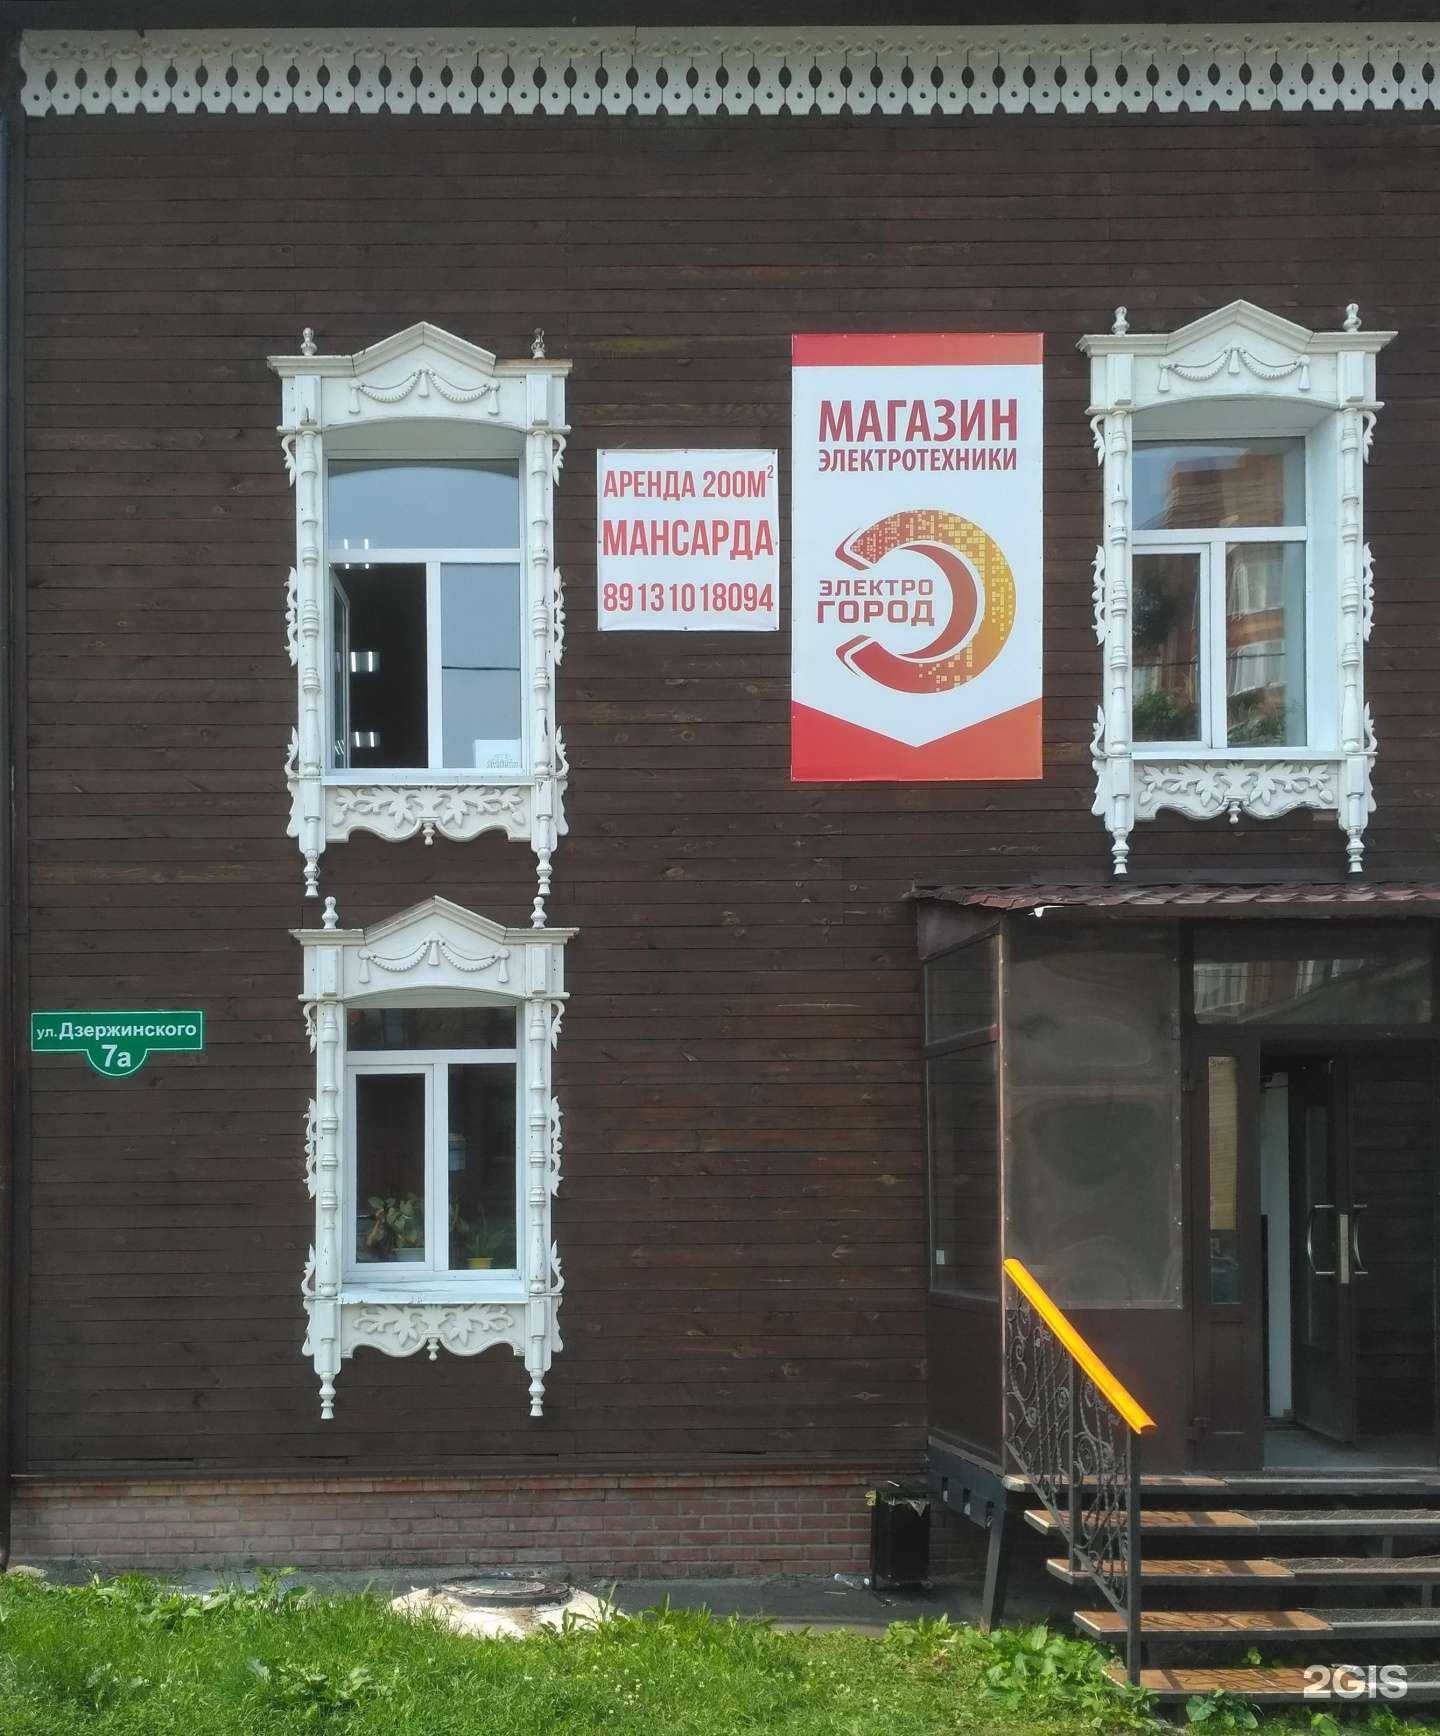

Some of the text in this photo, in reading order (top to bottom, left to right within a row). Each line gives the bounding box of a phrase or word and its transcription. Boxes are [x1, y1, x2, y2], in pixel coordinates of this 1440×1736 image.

[818, 398, 1018, 442] МАГАЗИН
[818, 447, 1017, 472] ЭЛЕКТРОТЕХНИКИ
[603, 470, 696, 501] АРЕНДА
[602, 519, 774, 561] МАНСАРДА
[603, 582, 774, 612] 89131018094
[818, 579, 934, 597] ЭЛЕКТРО
[817, 600, 935, 627] ГОРОД
[59, 1022, 197, 1040] Дзержинского
[101, 1044, 131, 1067] 7а
